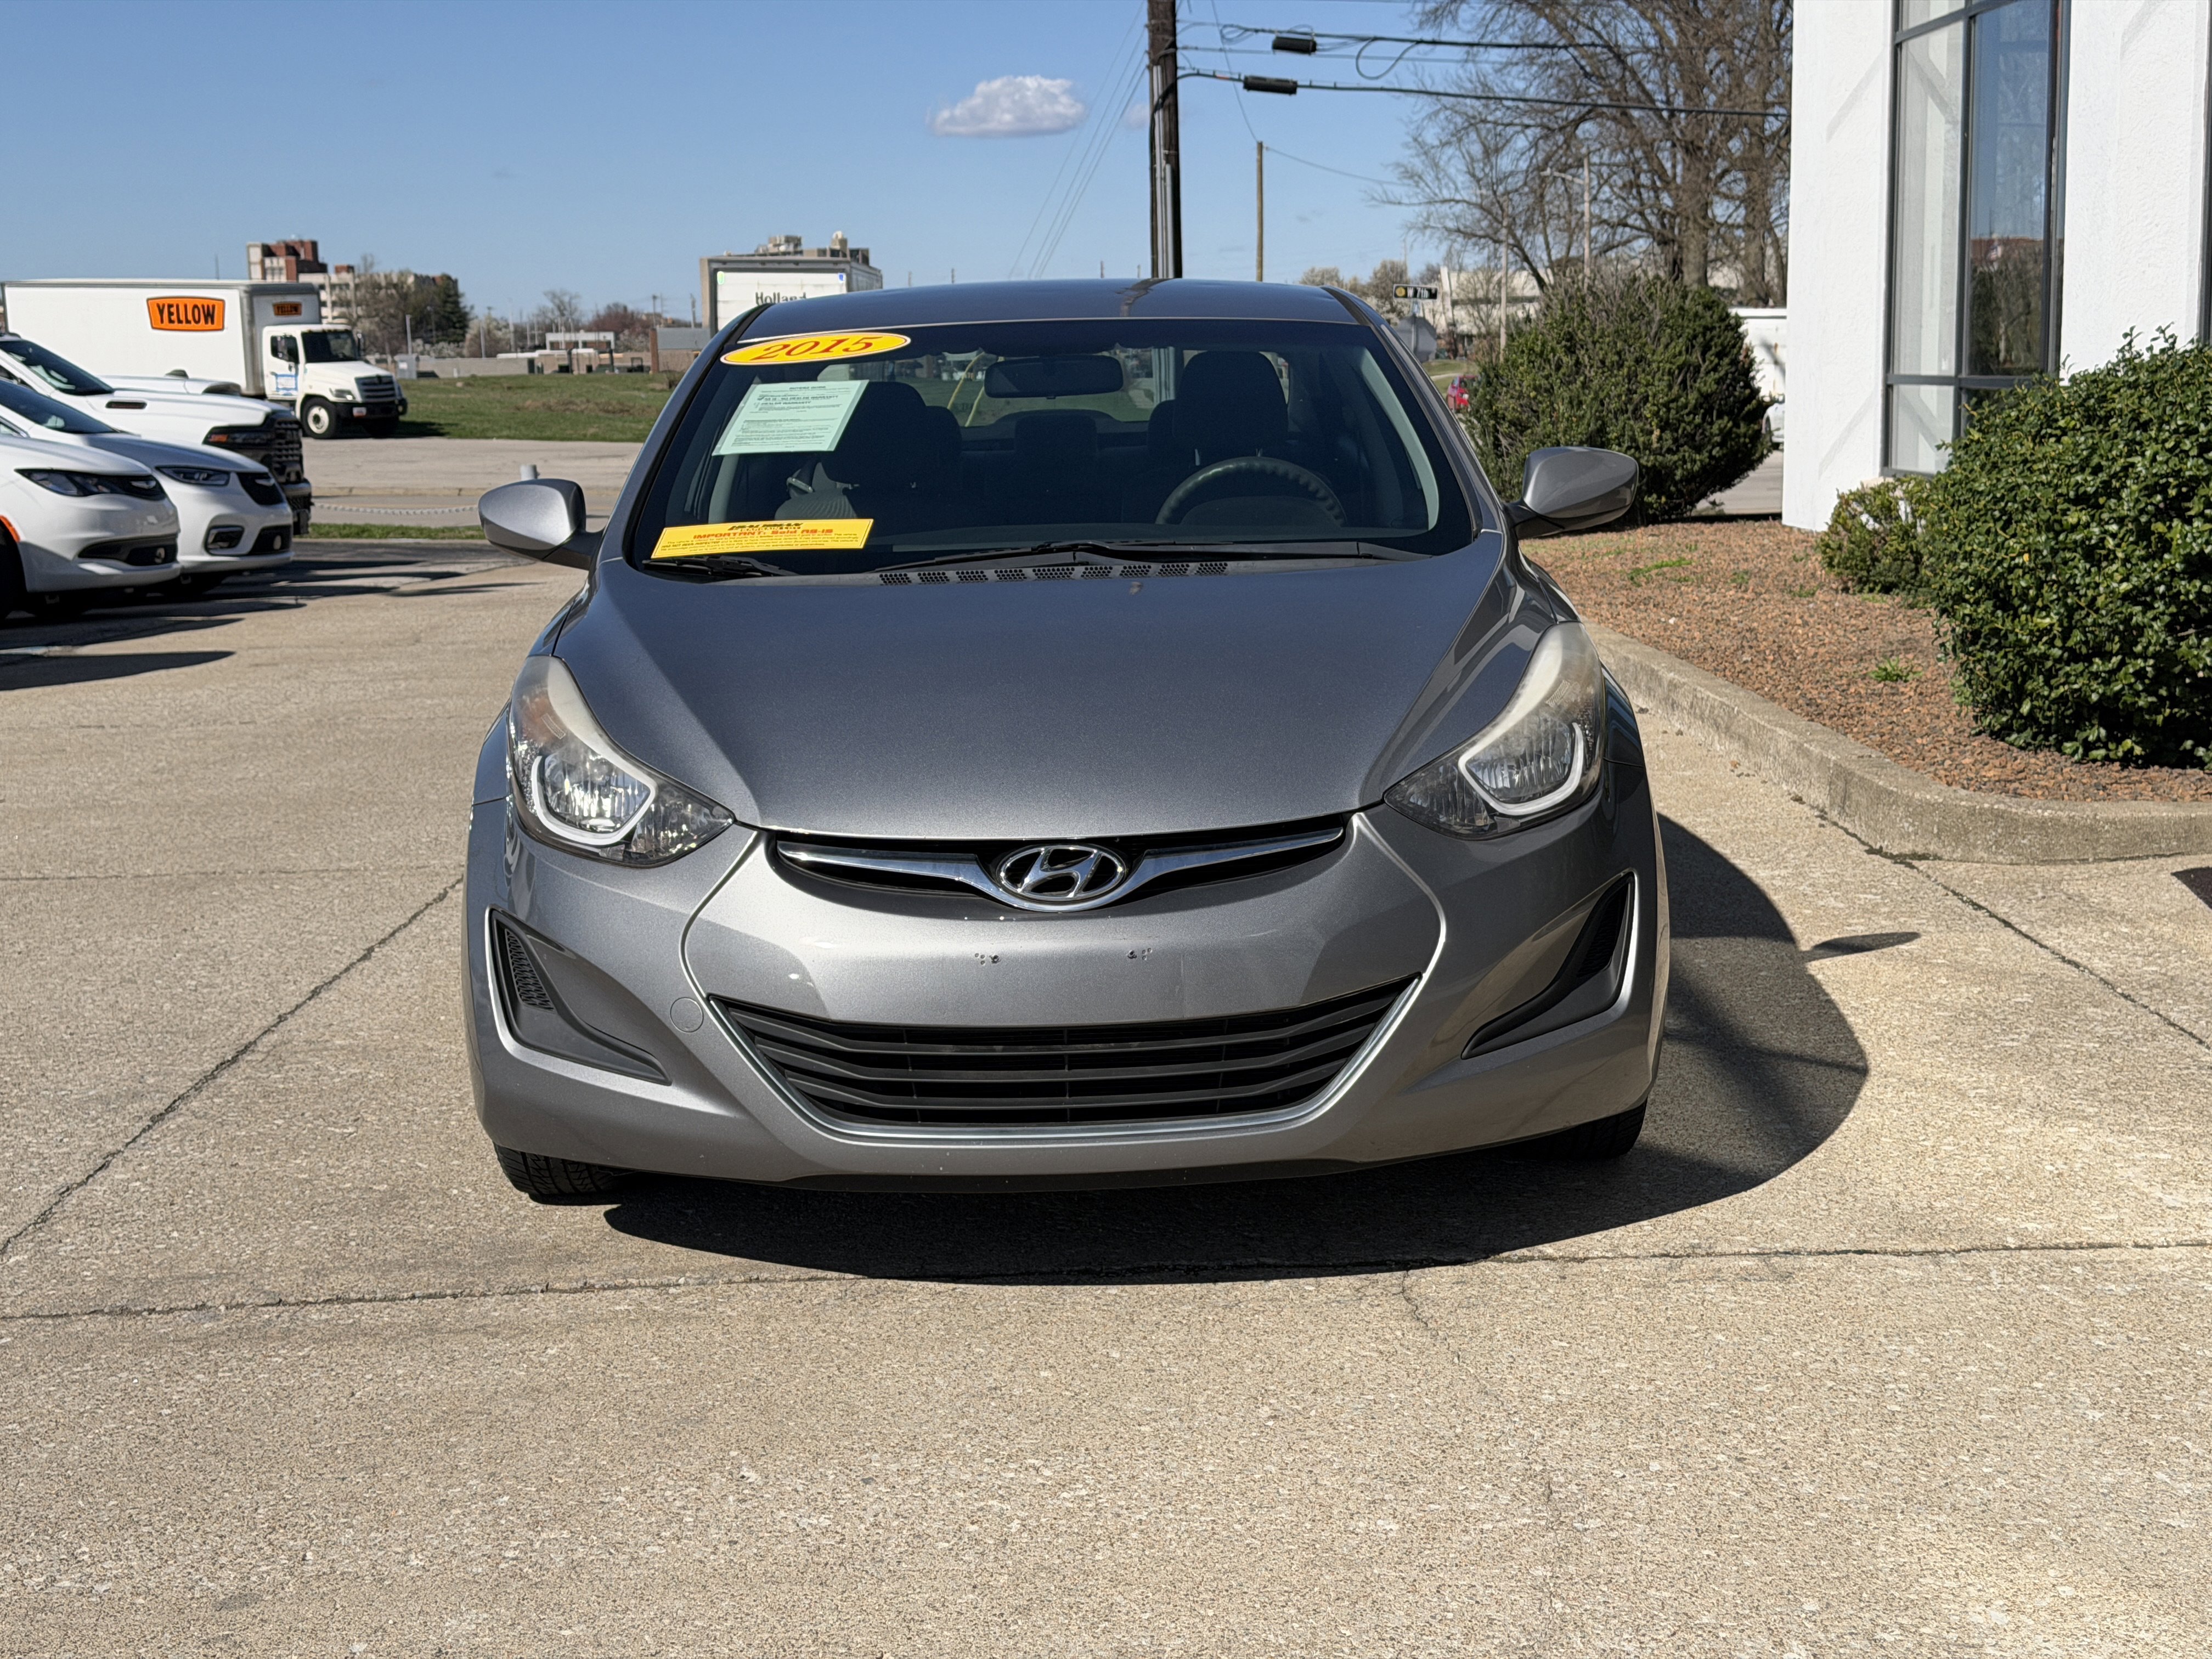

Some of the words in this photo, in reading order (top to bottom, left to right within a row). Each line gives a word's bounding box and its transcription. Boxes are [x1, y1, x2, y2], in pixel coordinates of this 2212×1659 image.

[1407, 287, 1414, 297] W
[1417, 287, 1429, 298] 7th
[156, 302, 215, 325] YELLOW
[749, 336, 883, 361] 2015
[693, 531, 766, 539] IMPORTANT:
